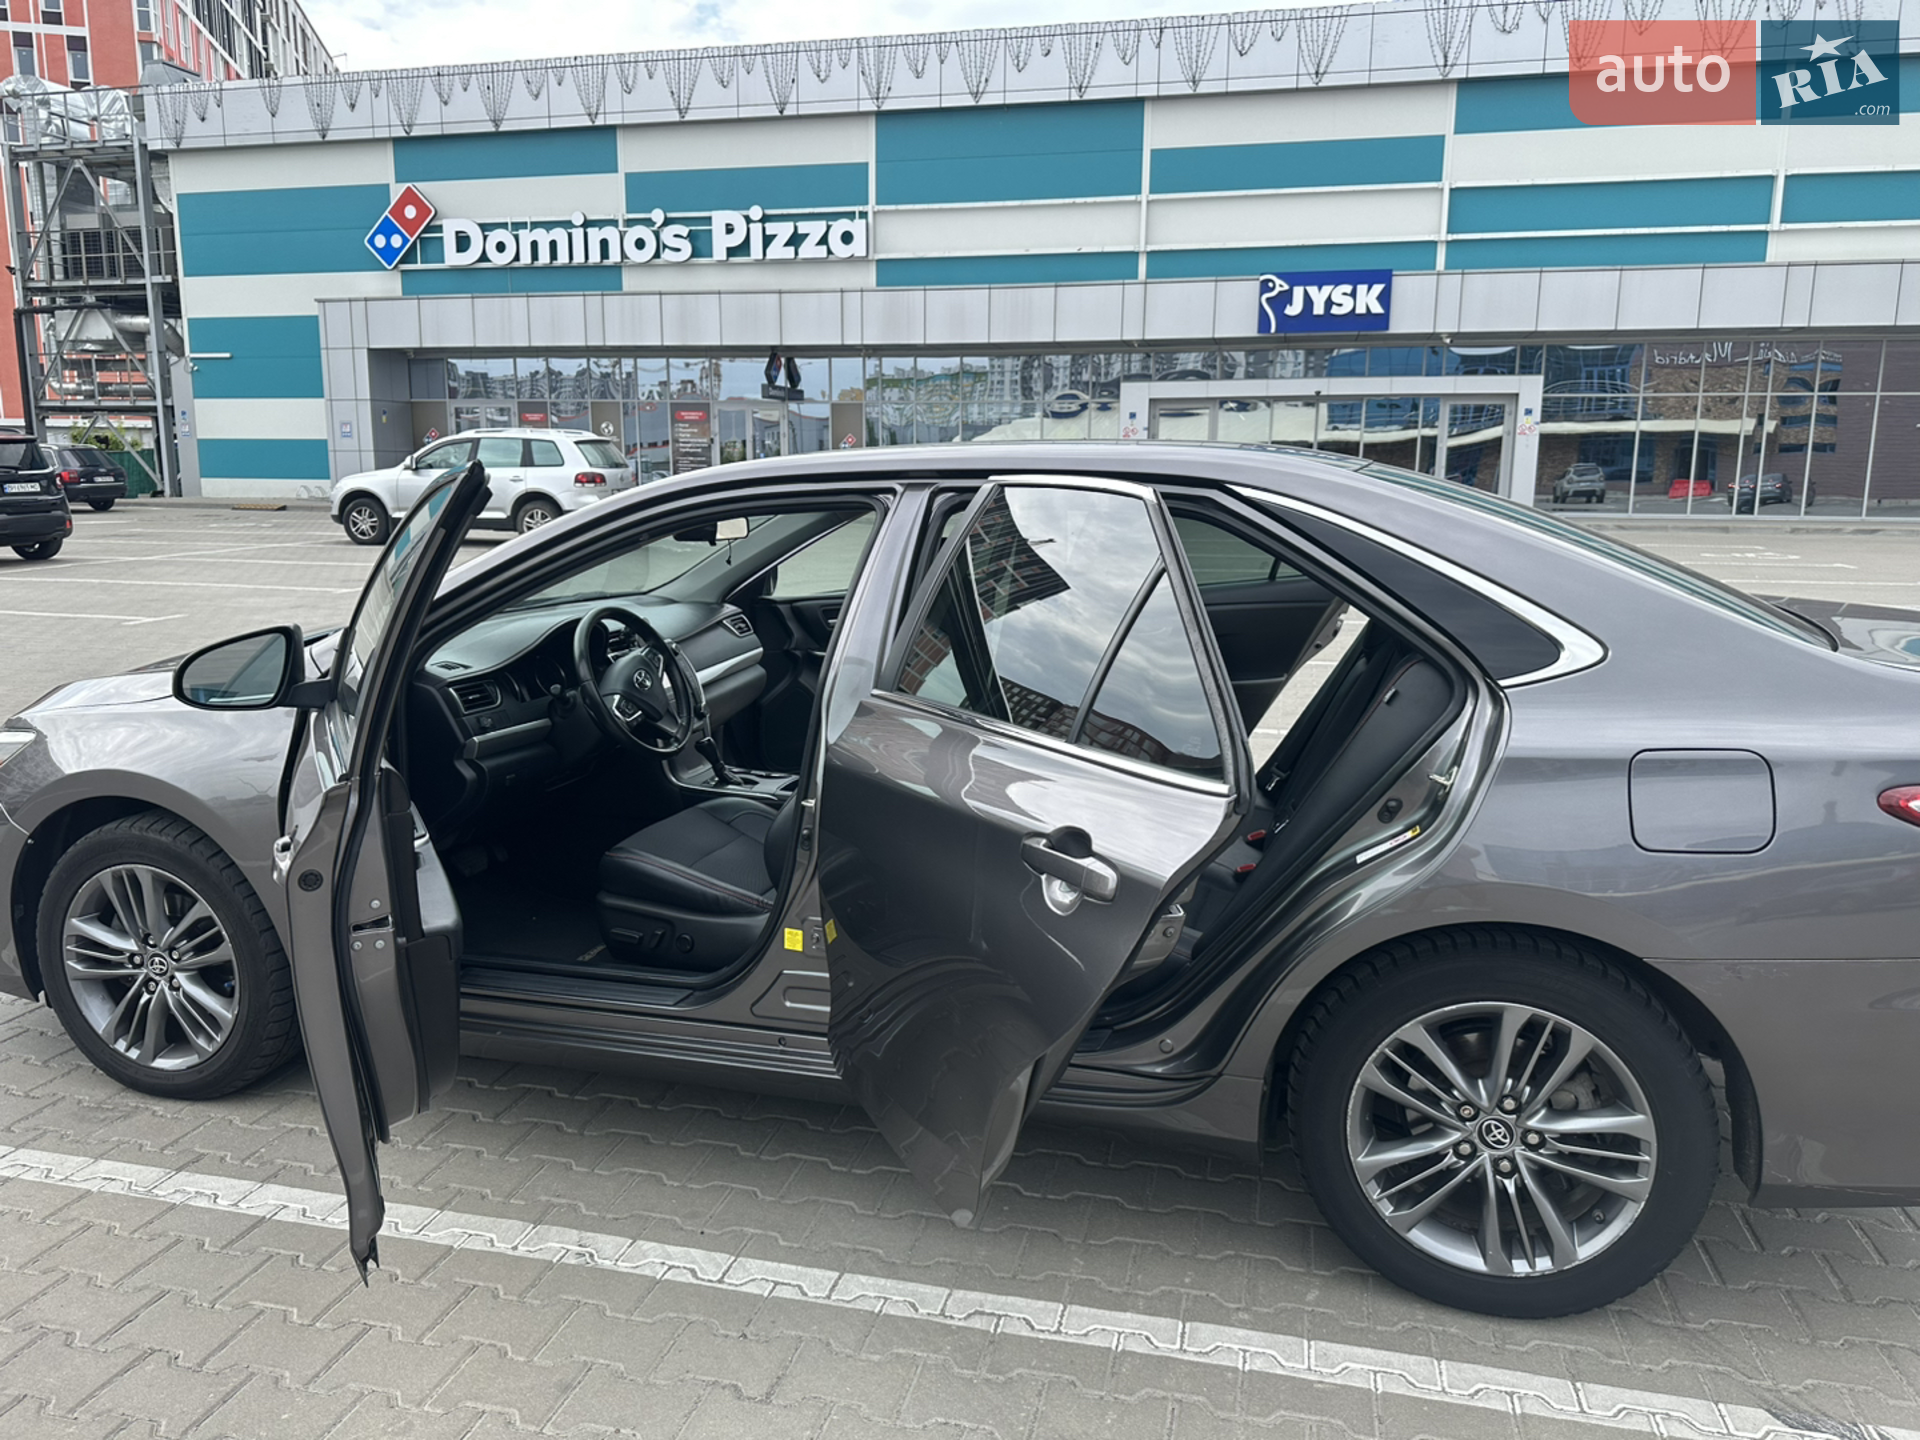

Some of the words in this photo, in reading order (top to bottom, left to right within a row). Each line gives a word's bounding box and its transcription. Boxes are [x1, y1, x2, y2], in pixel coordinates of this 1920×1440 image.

[443, 208, 693, 267] Domino's
[711, 204, 868, 262] Pizza
[1283, 283, 1387, 317] JYSK
